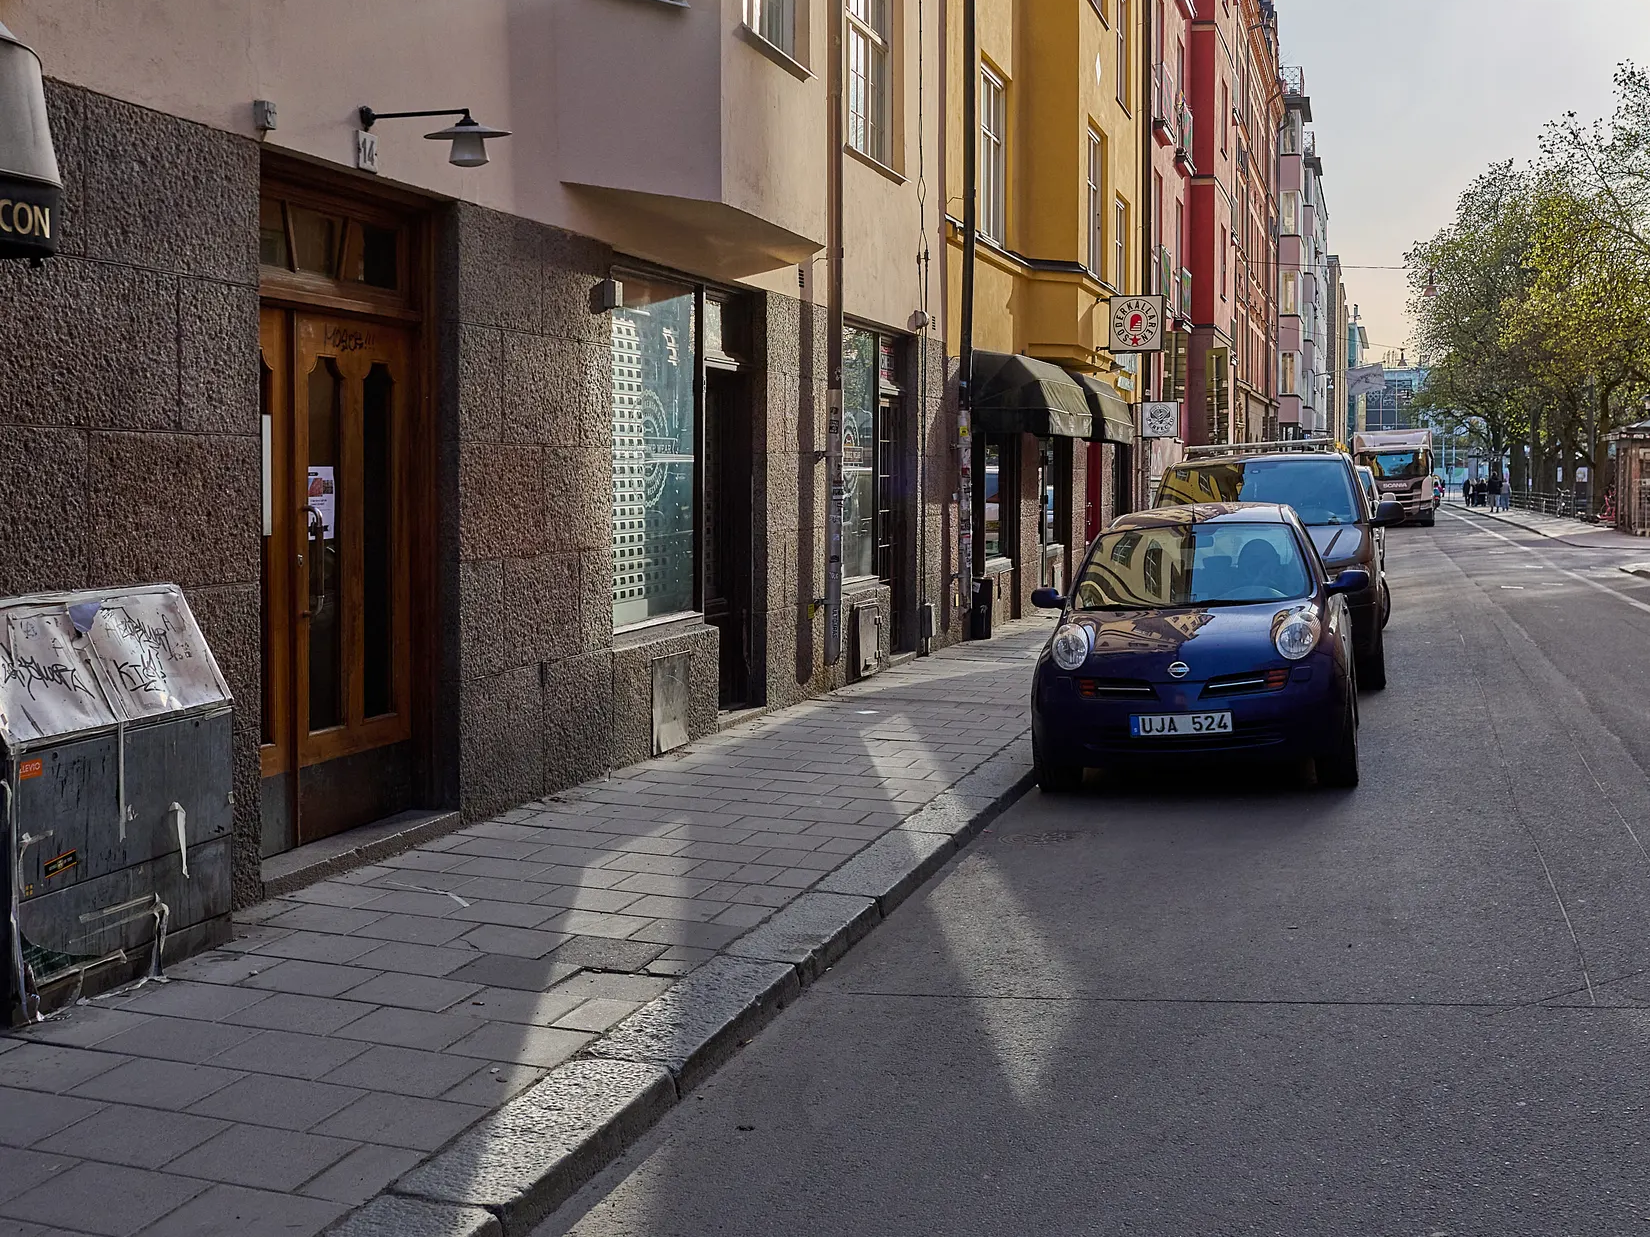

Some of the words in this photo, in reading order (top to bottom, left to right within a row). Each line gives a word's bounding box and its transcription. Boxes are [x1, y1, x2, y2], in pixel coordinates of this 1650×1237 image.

[361, 137, 375, 167] 14
[1147, 416, 1175, 431] PERFECTO
[1141, 716, 1178, 734] UJA
[1191, 714, 1229, 732] 524
